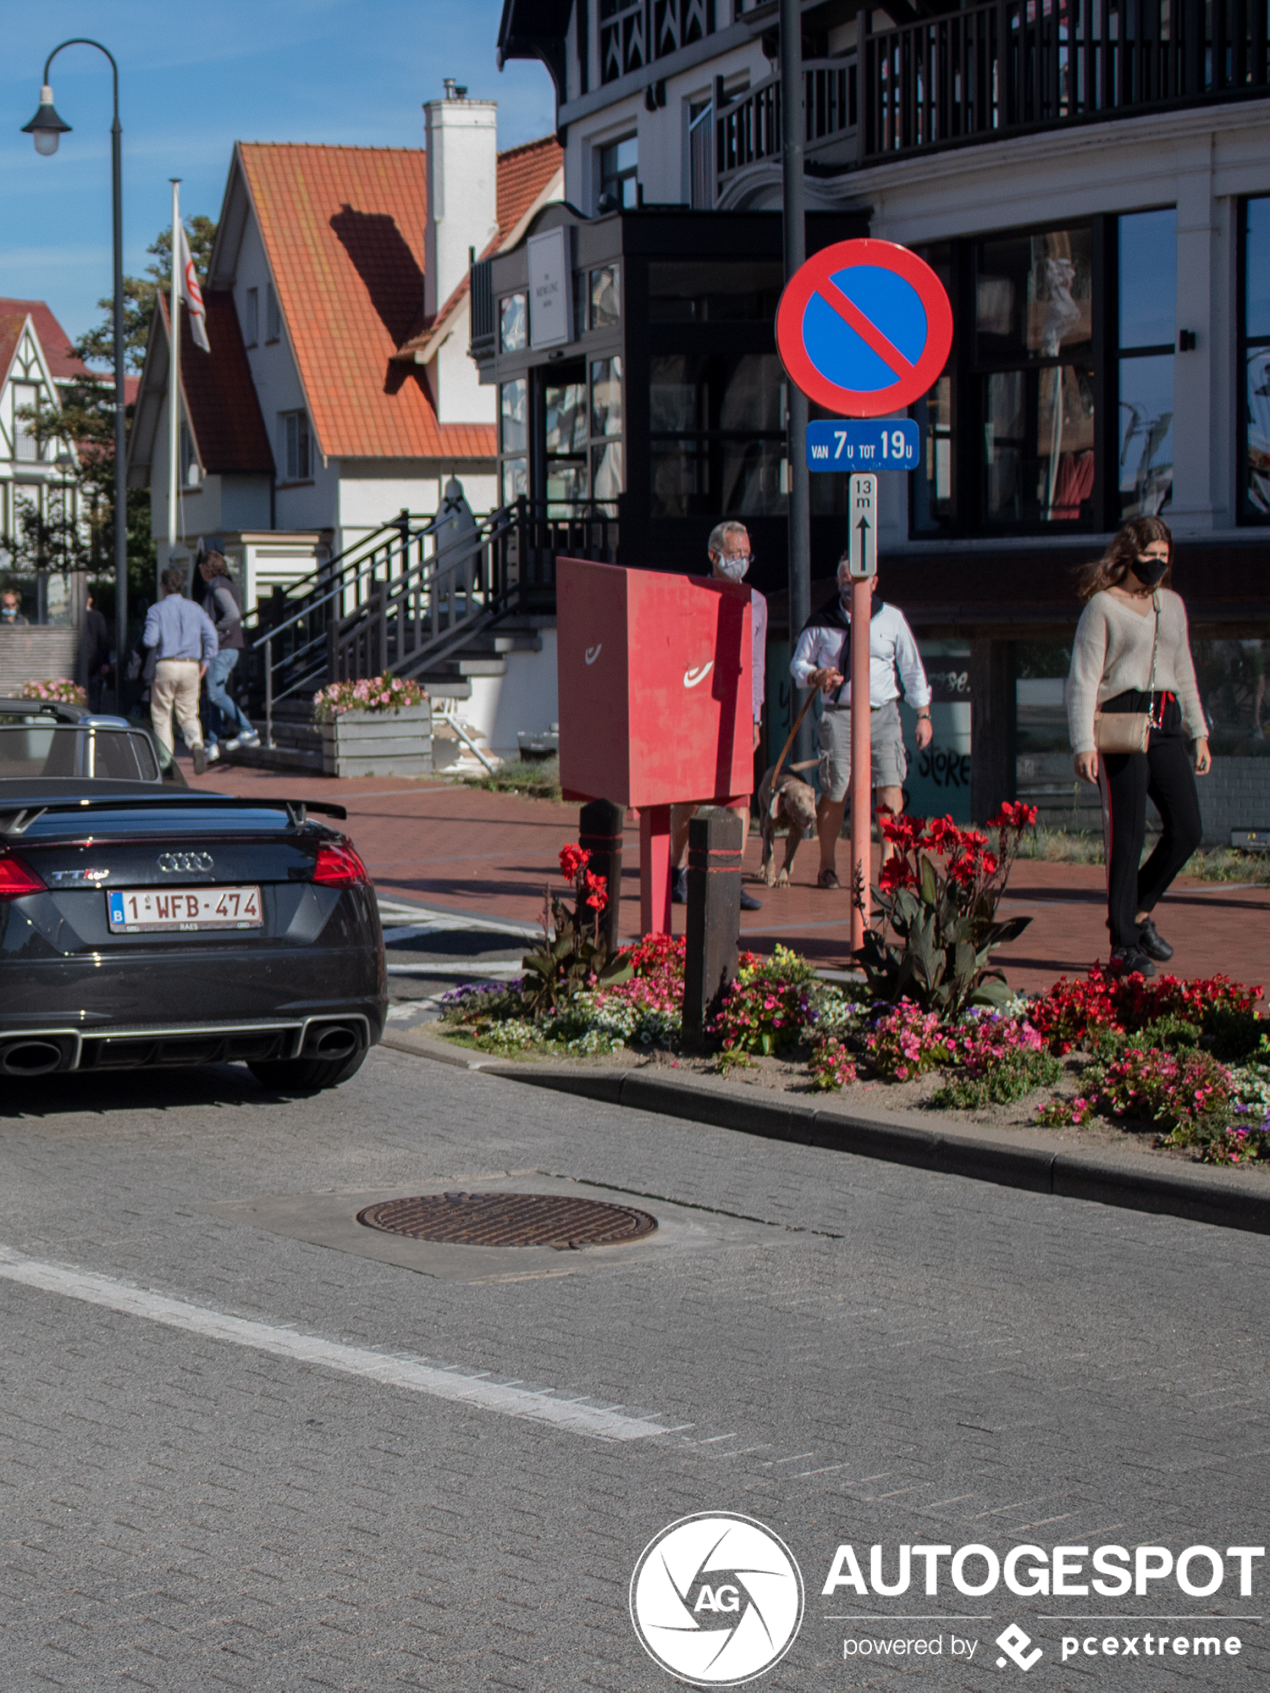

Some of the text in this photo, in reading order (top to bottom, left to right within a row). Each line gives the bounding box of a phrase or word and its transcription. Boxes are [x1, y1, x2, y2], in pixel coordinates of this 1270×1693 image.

[811, 445, 829, 459] VAN
[859, 445, 875, 459] TOT
[856, 480, 872, 494] 13
[856, 497, 871, 508] m
[113, 909, 123, 922] B
[179, 923, 199, 931] RAES
